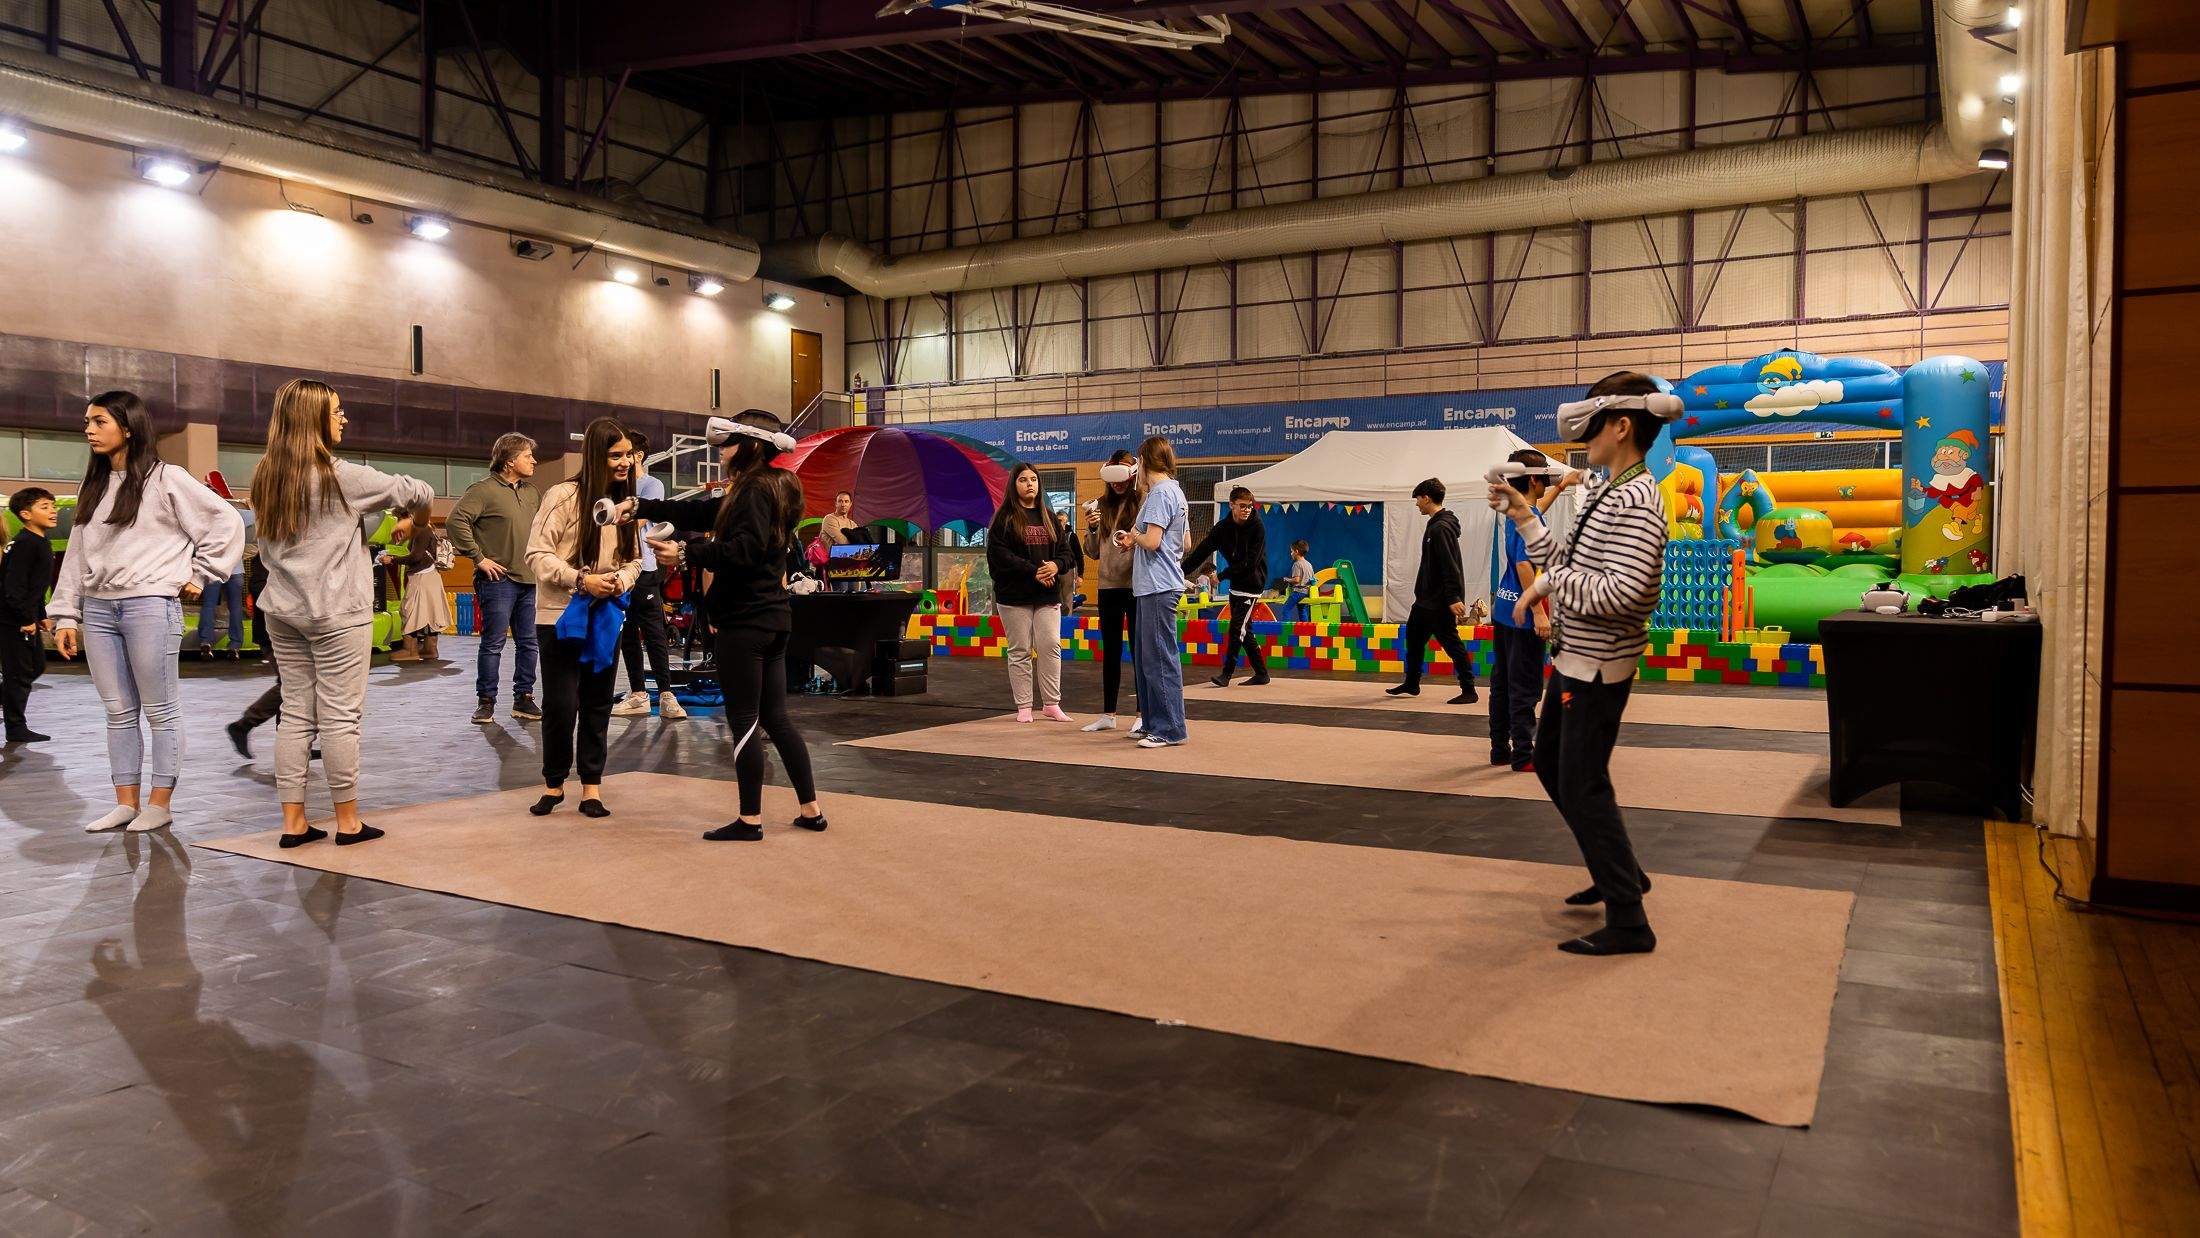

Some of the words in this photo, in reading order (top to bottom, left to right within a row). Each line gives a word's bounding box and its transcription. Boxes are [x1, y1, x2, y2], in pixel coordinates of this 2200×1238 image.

[1443, 407, 1517, 421] Encamp
[1285, 415, 1351, 429] Encamp
[1366, 419, 1427, 430] www.encamp.ad
[1143, 423, 1203, 435] Encamp
[1216, 426, 1272, 436] www.encamp.ad
[1015, 430, 1069, 442] Encamp
[1081, 433, 1131, 443] www.encamp.ad
